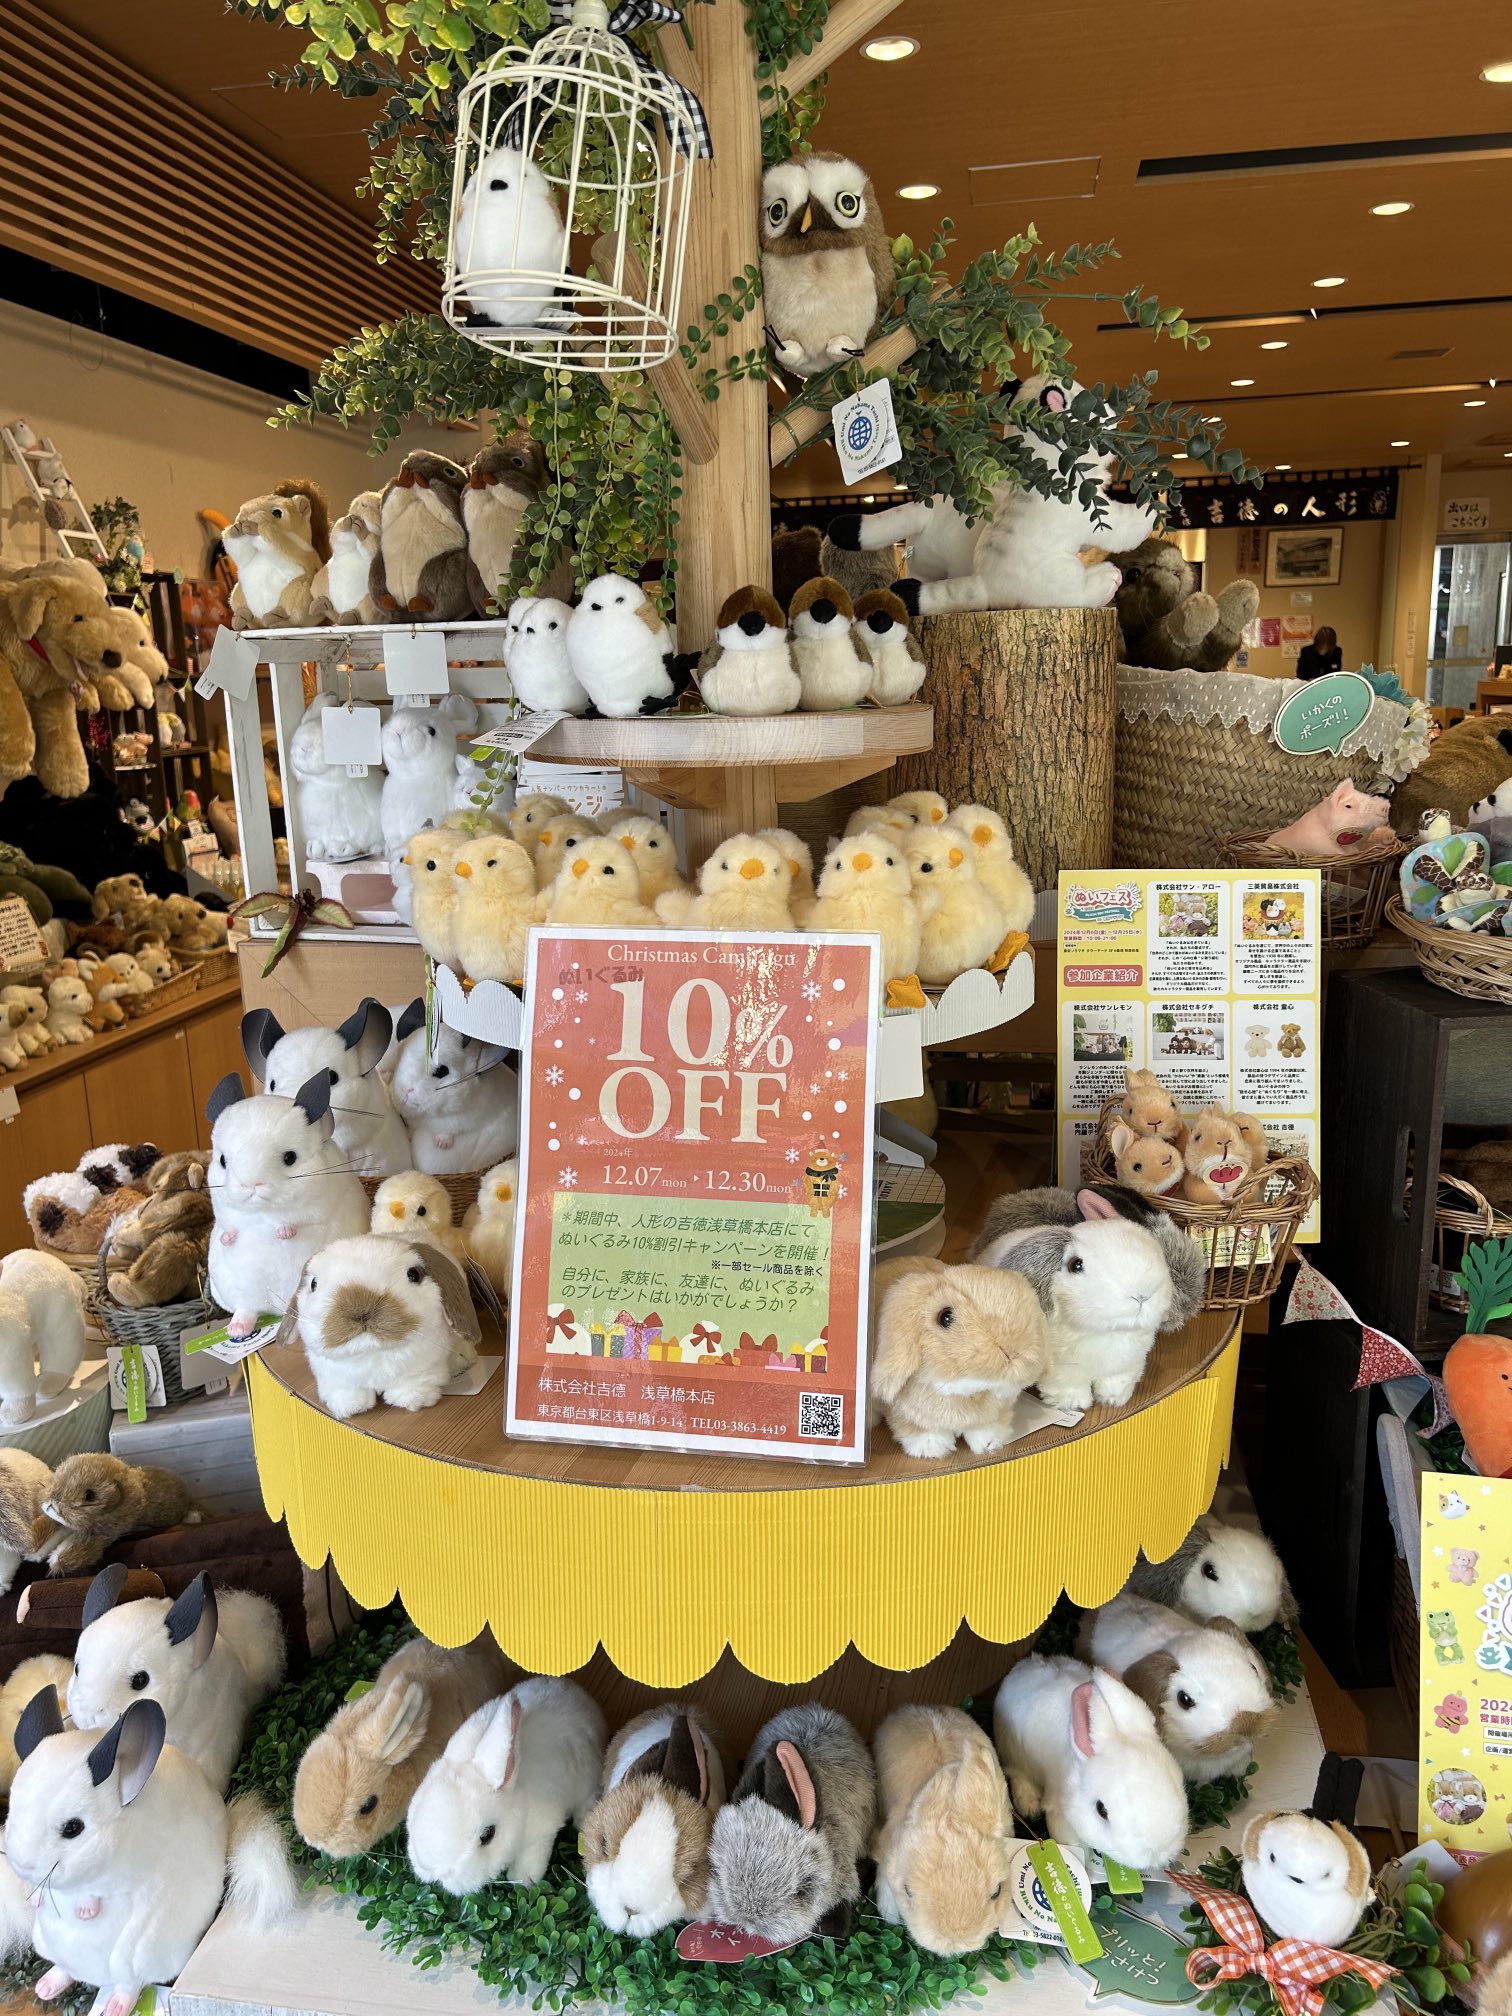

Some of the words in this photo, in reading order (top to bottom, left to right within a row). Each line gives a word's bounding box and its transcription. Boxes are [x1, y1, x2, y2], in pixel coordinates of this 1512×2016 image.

[1448, 502, 1479, 513] 出口は
[1451, 517, 1488, 528] こちらです
[1301, 695, 1342, 721] いかくの
[1300, 709, 1349, 740] ポーズ！！
[607, 944, 698, 963] Christmas
[558, 965, 645, 985] ぬいぐるみ
[1067, 969, 1138, 982] 参加企業紹介
[605, 977, 794, 1067] 10%
[598, 1066, 788, 1144] OFF
[603, 1147, 633, 1157] 2024年
[711, 1259, 824, 1277] ※一部セール商品を除く
[562, 1266, 816, 1296] 自分に、家族に、友達に、ぬいぐるみ
[561, 1285, 798, 1313] のプレゼントはいかがでしょうか？
[640, 1386, 716, 1406] 浅草橋本店
[1480, 1713, 1512, 1726] 営業時
[1018, 1871, 1026, 1888] Umi
[1024, 1861, 1032, 1870] No
[1034, 1909, 1045, 1920] No
